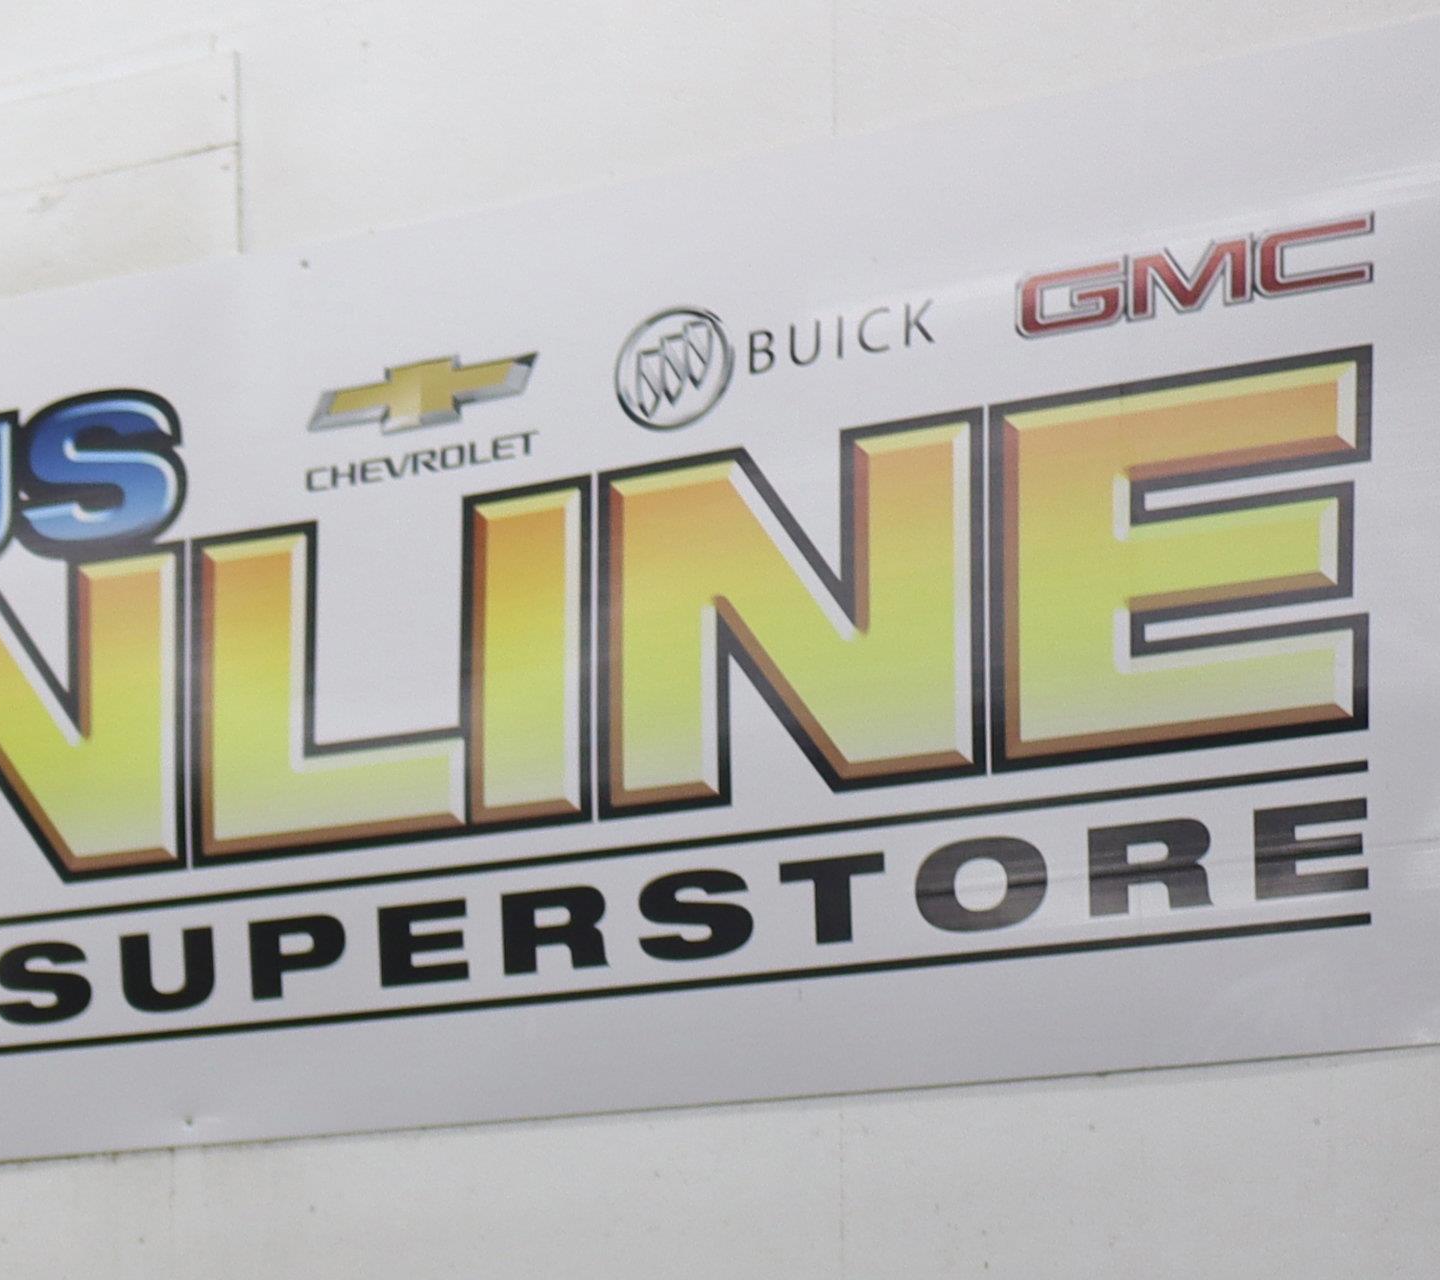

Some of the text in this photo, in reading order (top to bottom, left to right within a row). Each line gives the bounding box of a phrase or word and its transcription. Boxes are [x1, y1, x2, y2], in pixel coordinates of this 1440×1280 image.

[1015, 211, 1374, 339] GMC
[747, 300, 935, 375] BUICK
[306, 430, 539, 493] CHEVROLET
